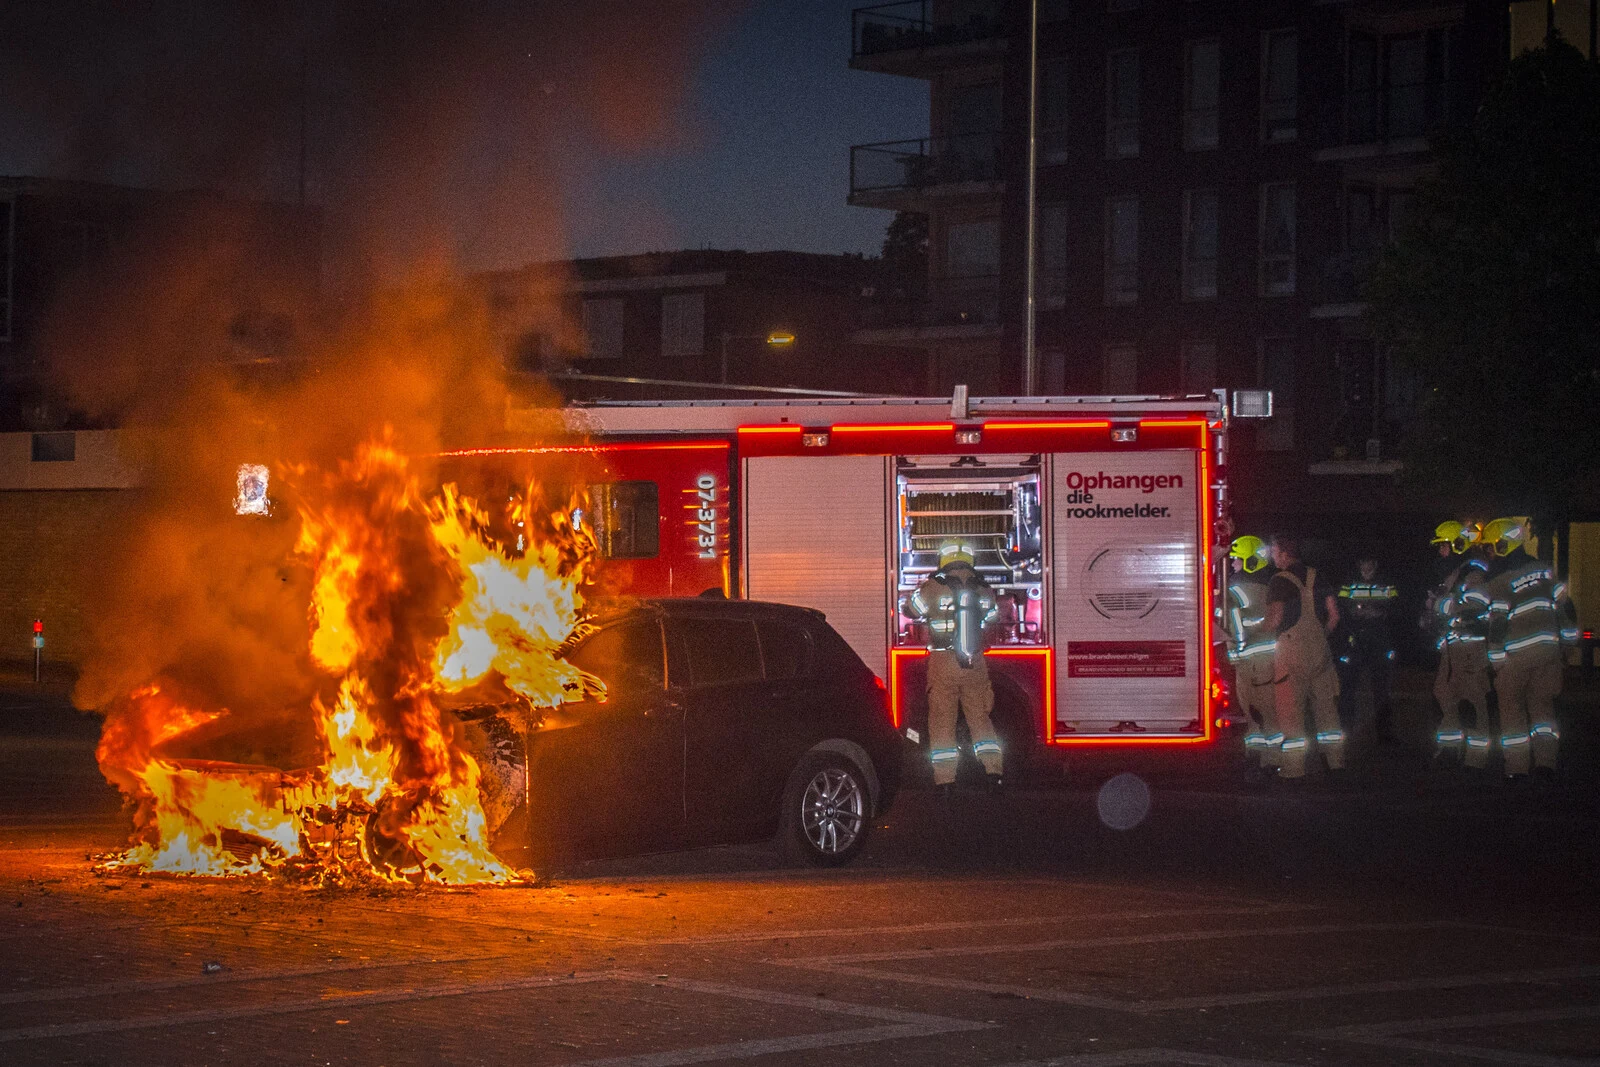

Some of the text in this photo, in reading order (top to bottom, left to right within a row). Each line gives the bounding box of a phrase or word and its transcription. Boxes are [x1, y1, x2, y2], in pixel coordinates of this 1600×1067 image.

[1066, 472, 1183, 493] Ophangen
[1066, 490, 1094, 504] die
[698, 475, 716, 559] 07-3731
[1066, 504, 1171, 519] rookmelder.
